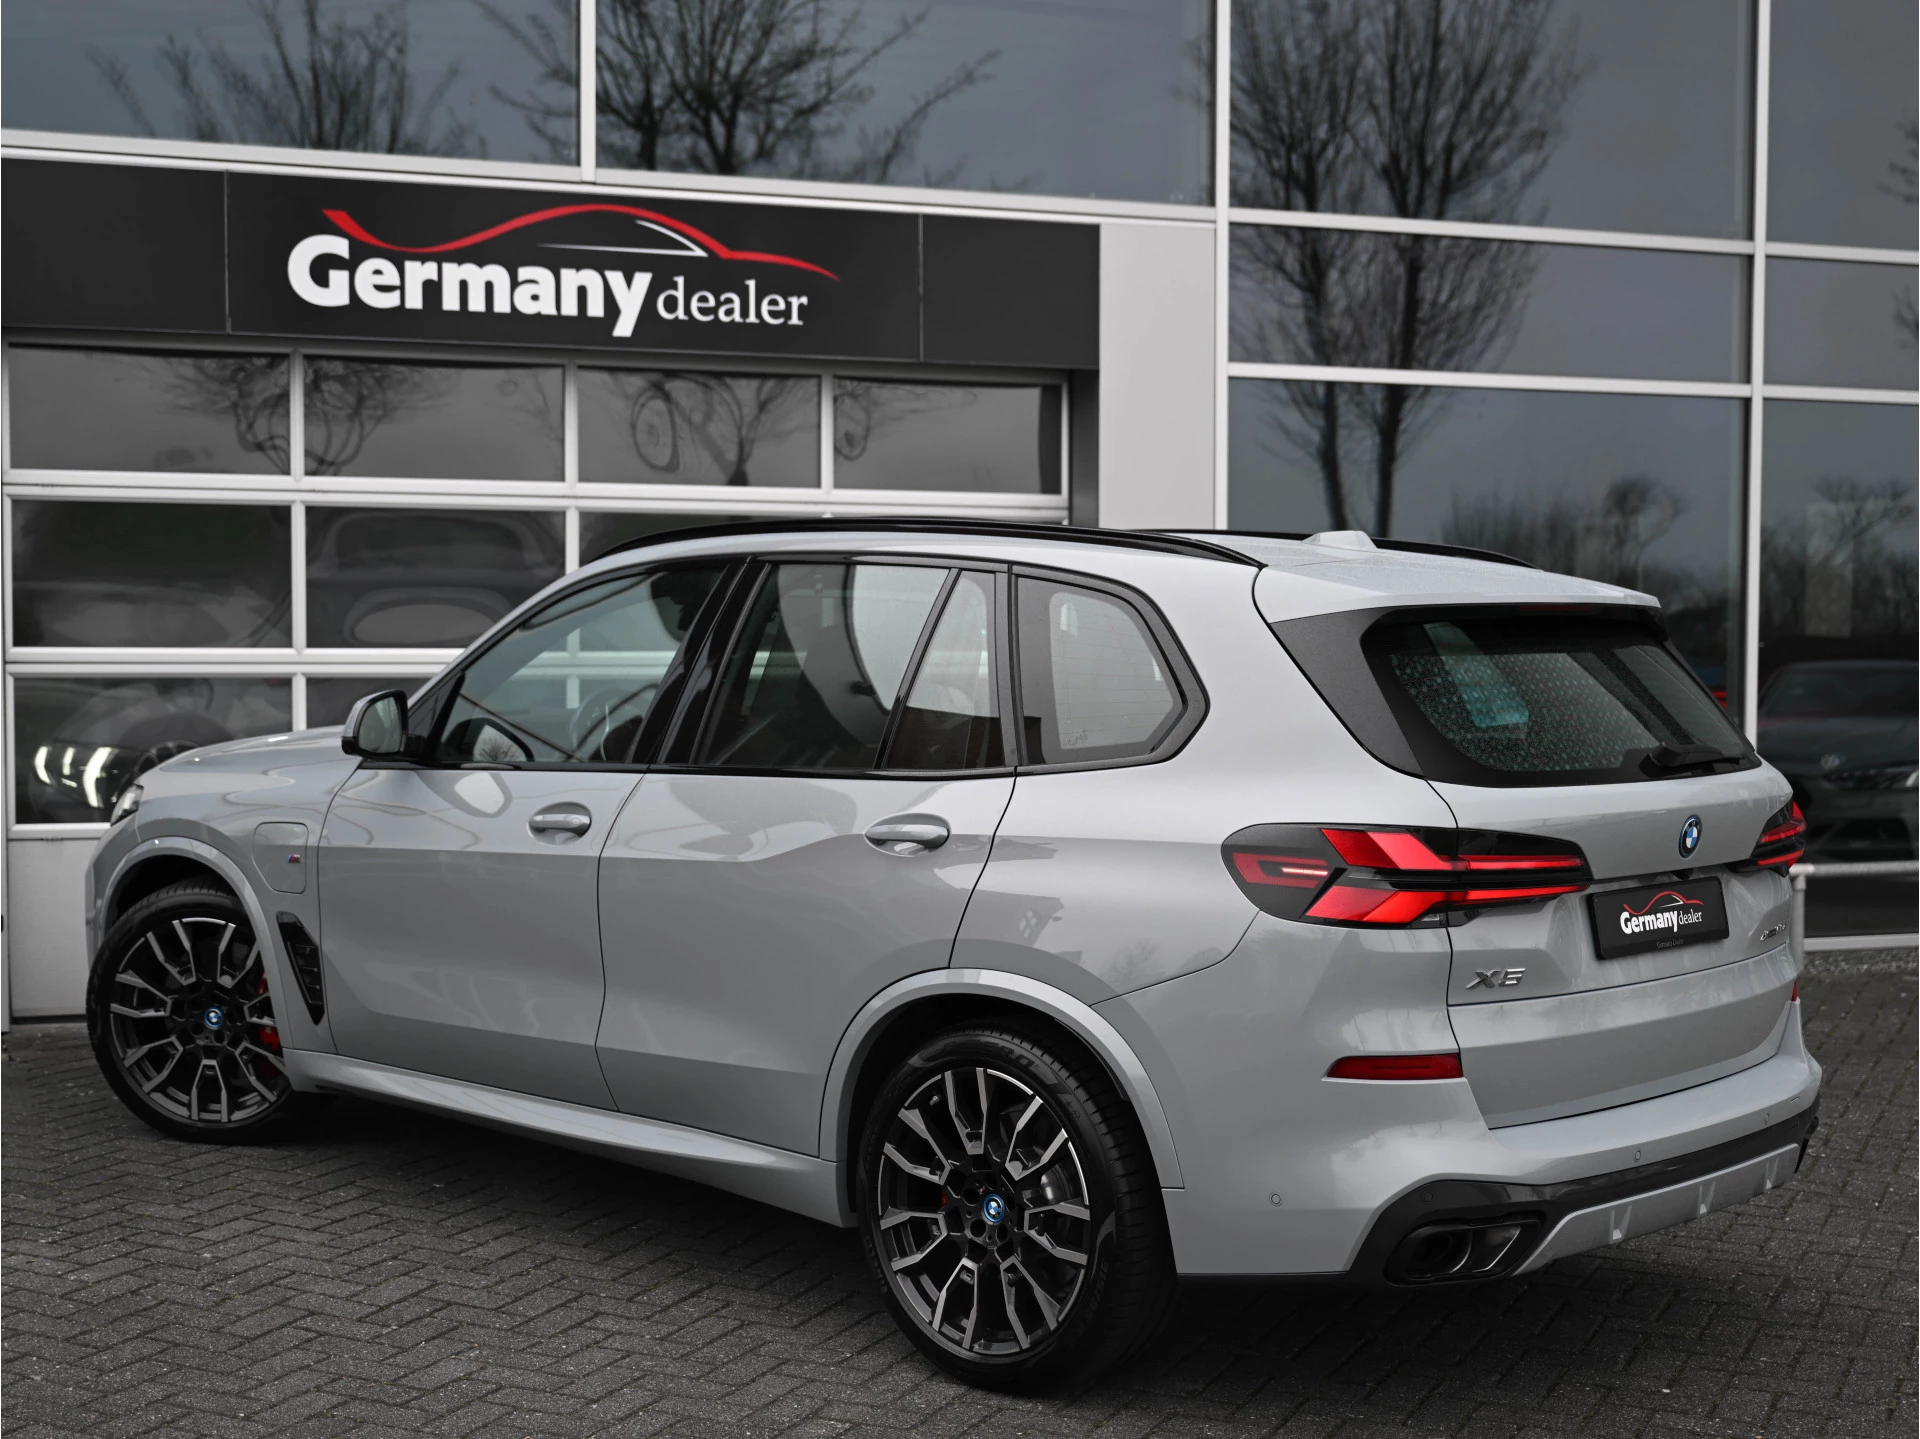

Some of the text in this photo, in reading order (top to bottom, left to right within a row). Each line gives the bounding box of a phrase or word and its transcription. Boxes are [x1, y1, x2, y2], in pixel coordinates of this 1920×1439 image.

[287, 234, 809, 338] Germany dealer
[1619, 908, 1702, 934] Germany dealer
